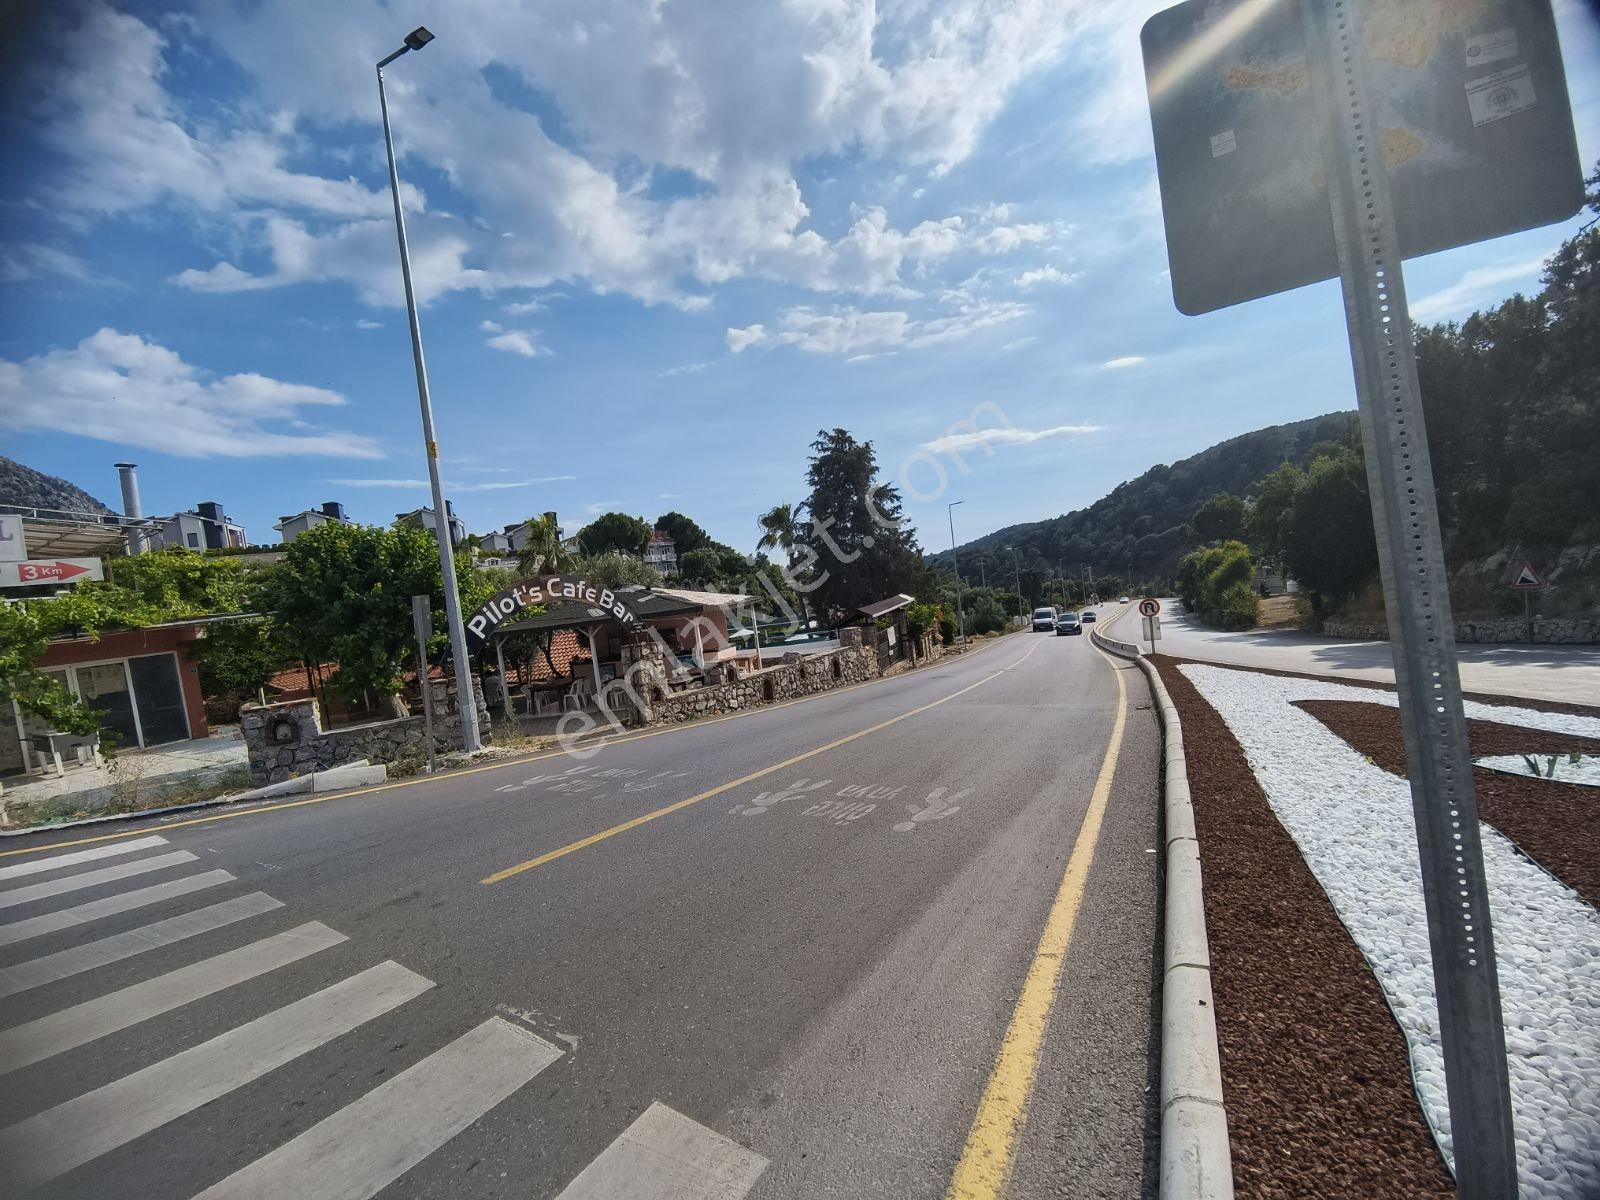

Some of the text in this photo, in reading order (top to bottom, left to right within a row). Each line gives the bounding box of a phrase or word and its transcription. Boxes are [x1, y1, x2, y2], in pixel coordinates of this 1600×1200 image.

[24, 565, 63, 580] 3 Km
[467, 578, 634, 639] Pilot's Cafe Bar
